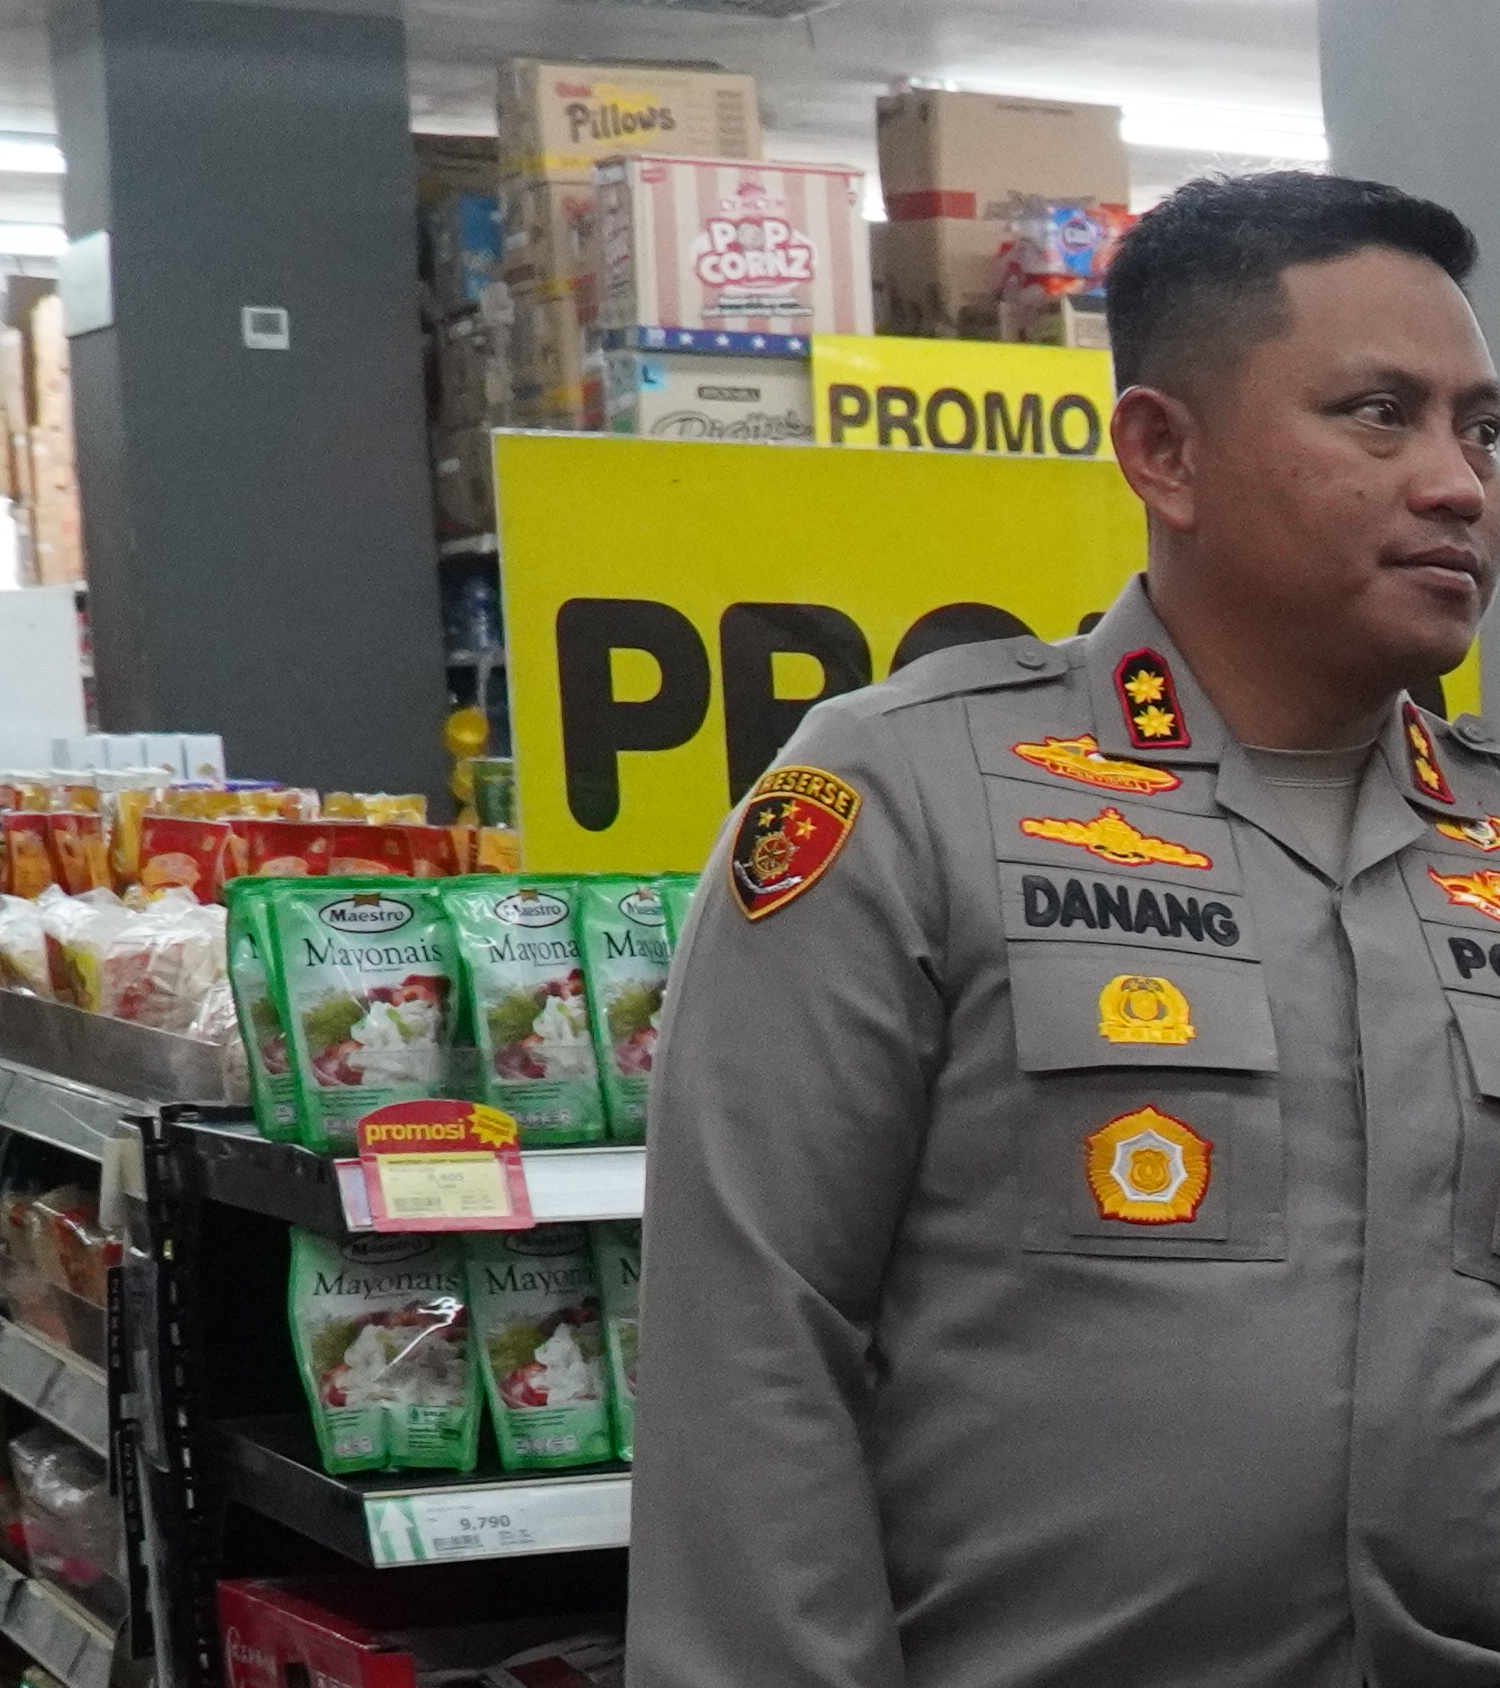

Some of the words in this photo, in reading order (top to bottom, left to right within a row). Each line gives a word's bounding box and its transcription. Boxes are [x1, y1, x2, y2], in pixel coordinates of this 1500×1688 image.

[564, 101, 677, 142] Pillows
[697, 246, 813, 284] CORNZ
[828, 382, 1102, 456] PROMO
[330, 907, 405, 924] Maestro
[1021, 874, 1241, 947] DANANG
[302, 936, 444, 969] Mayonais
[364, 1117, 467, 1146] promosi
